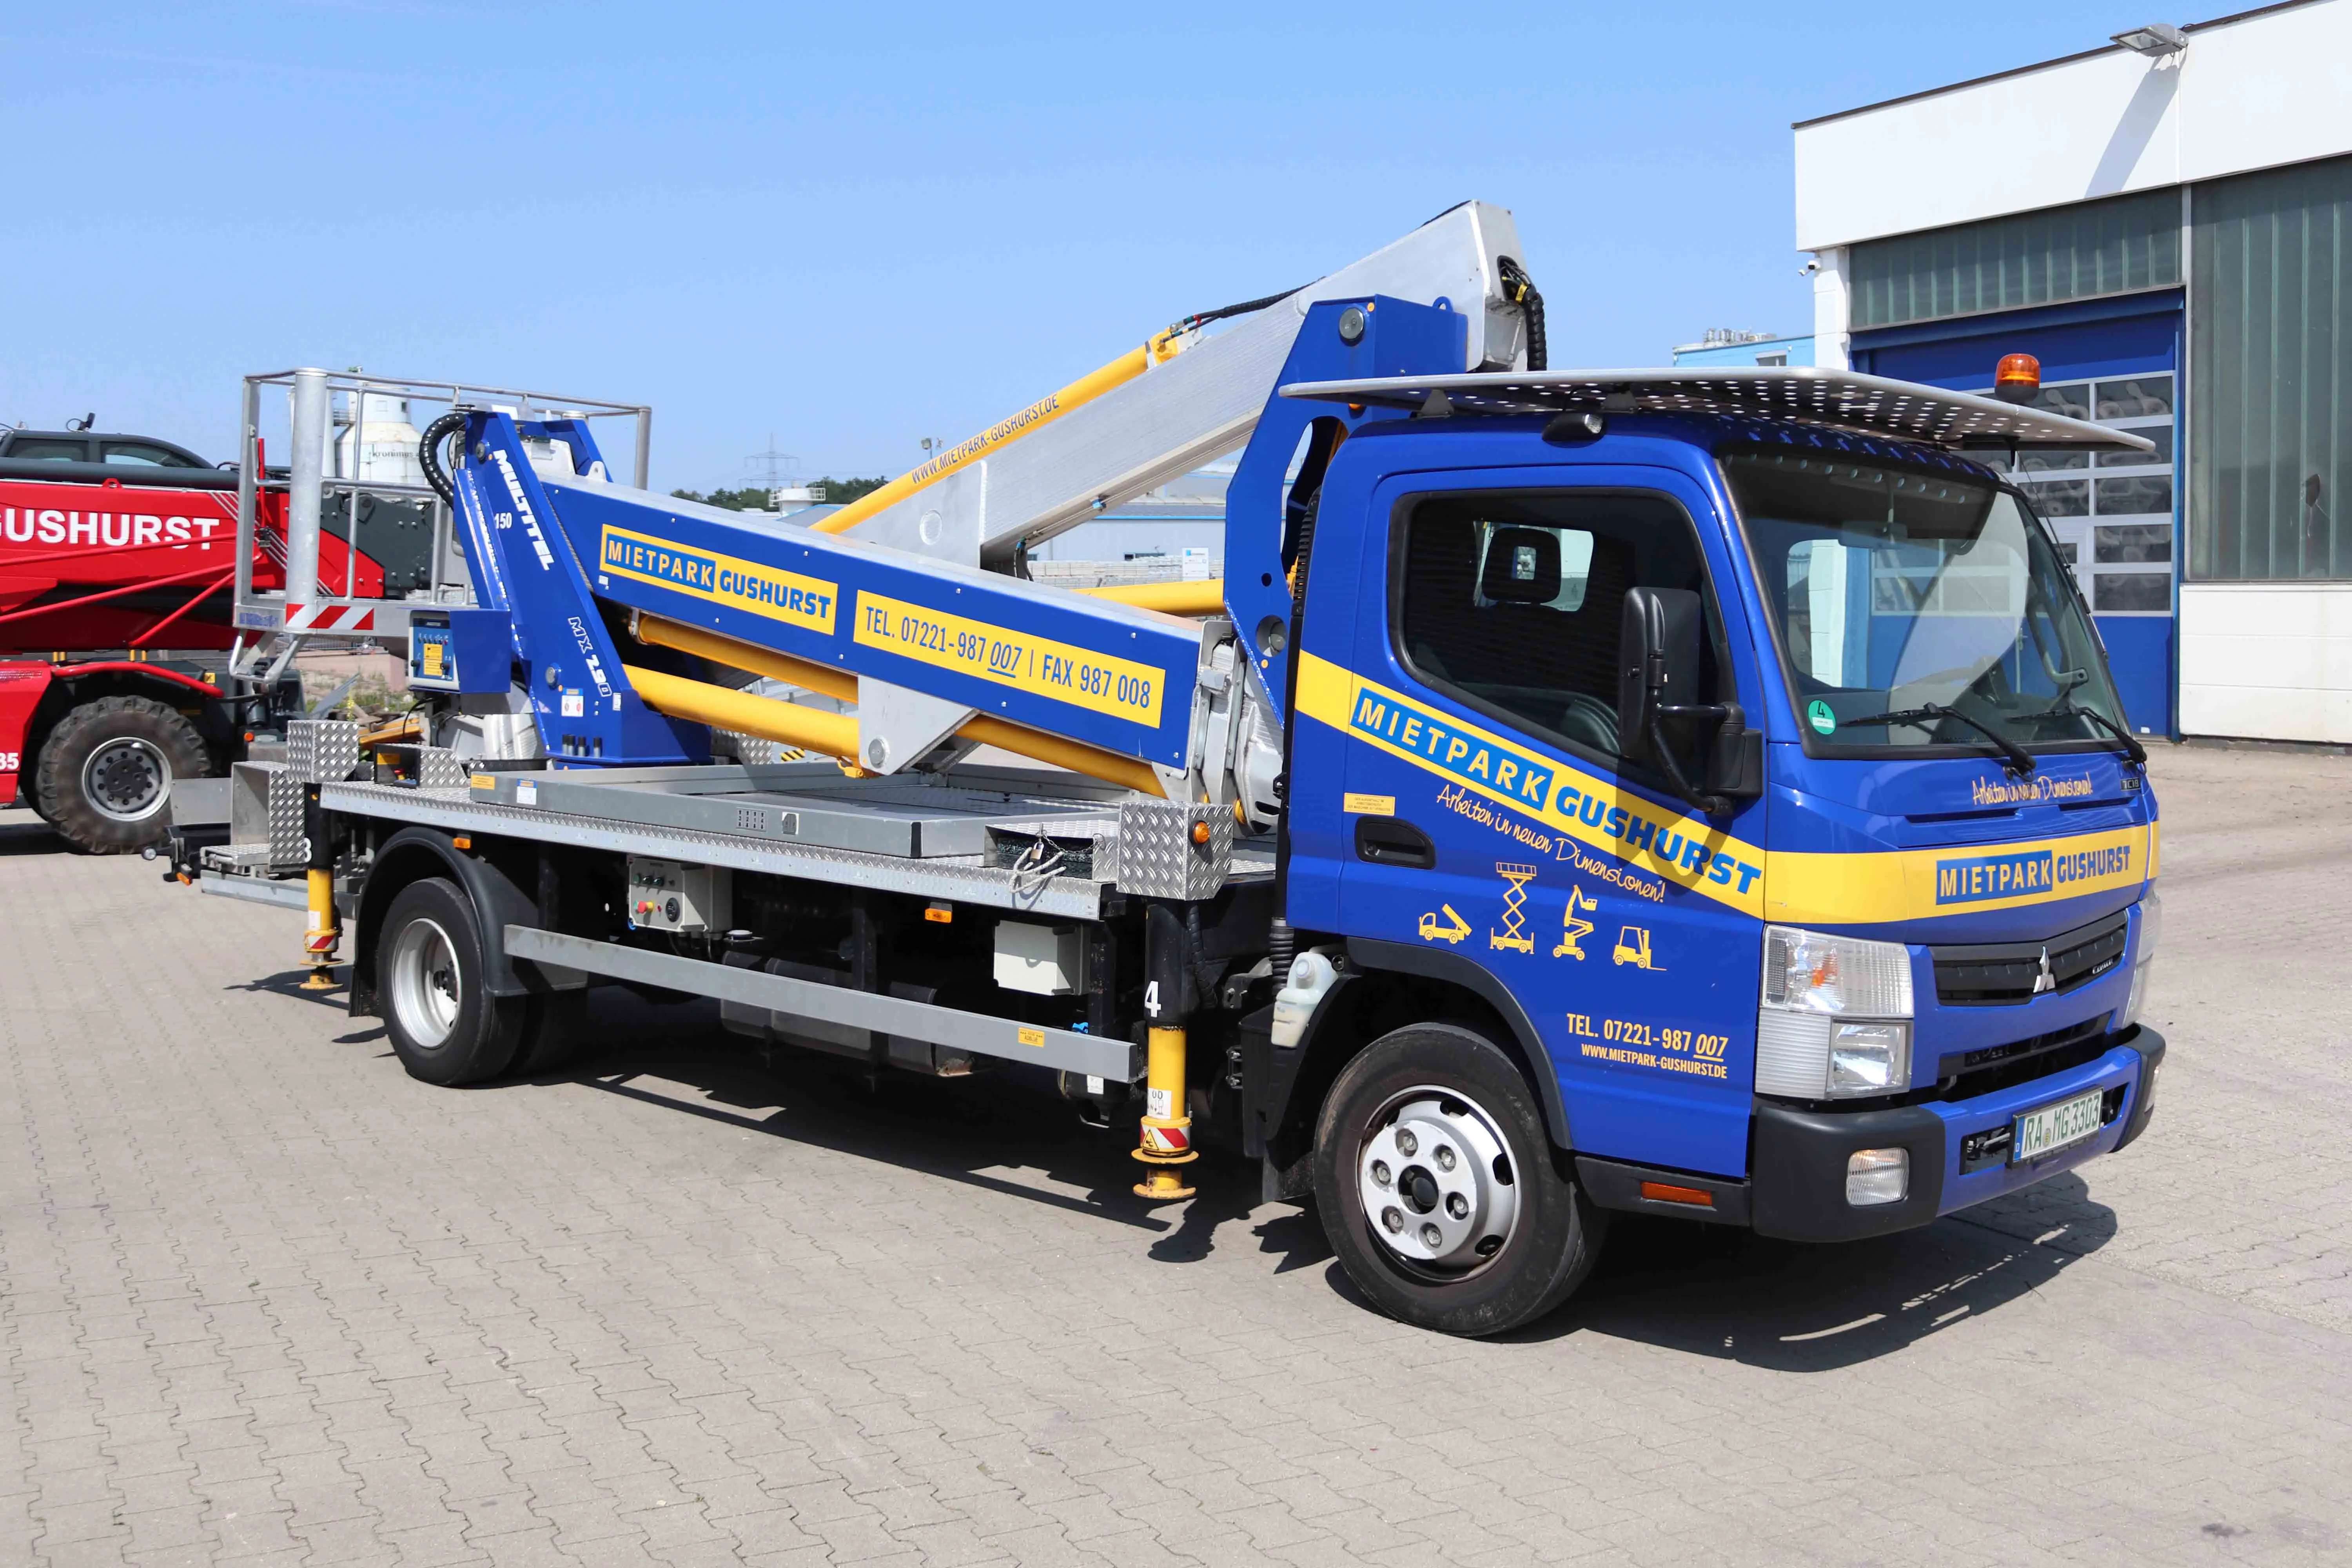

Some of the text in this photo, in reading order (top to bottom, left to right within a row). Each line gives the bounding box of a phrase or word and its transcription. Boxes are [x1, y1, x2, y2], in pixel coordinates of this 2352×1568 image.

[912, 393, 1059, 484] WWW.MIETPARK-GUSHURST.DE
[0, 508, 220, 550] USHURST
[493, 450, 554, 570] MULTITEL
[494, 512, 512, 529] 150
[608, 540, 831, 618] MIETPARK GUSHURST
[568, 617, 593, 654] MX
[866, 606, 895, 638] TEL.
[902, 616, 986, 662] 07221-987
[990, 641, 1022, 671] 007
[1043, 654, 1074, 687] FAX
[1080, 665, 1112, 697] 987
[1118, 675, 1151, 708] 008
[1817, 702, 1825, 717] 4
[1358, 698, 1762, 894] MIETPARK GUSHURST
[1437, 784, 1666, 902] Arbeiten in neuen Dimensionen!
[1940, 845, 2131, 897] MIETPARK GUSHURST
[1145, 981, 1161, 1018] 4
[1567, 1013, 1729, 1057] TEL. 07221-987 007
[1581, 1044, 1728, 1079] WWW.MIETPARK-GUSHURST.DE
[2015, 1142, 2020, 1152] D
[2024, 1094, 2100, 1152] RA MG 3303
